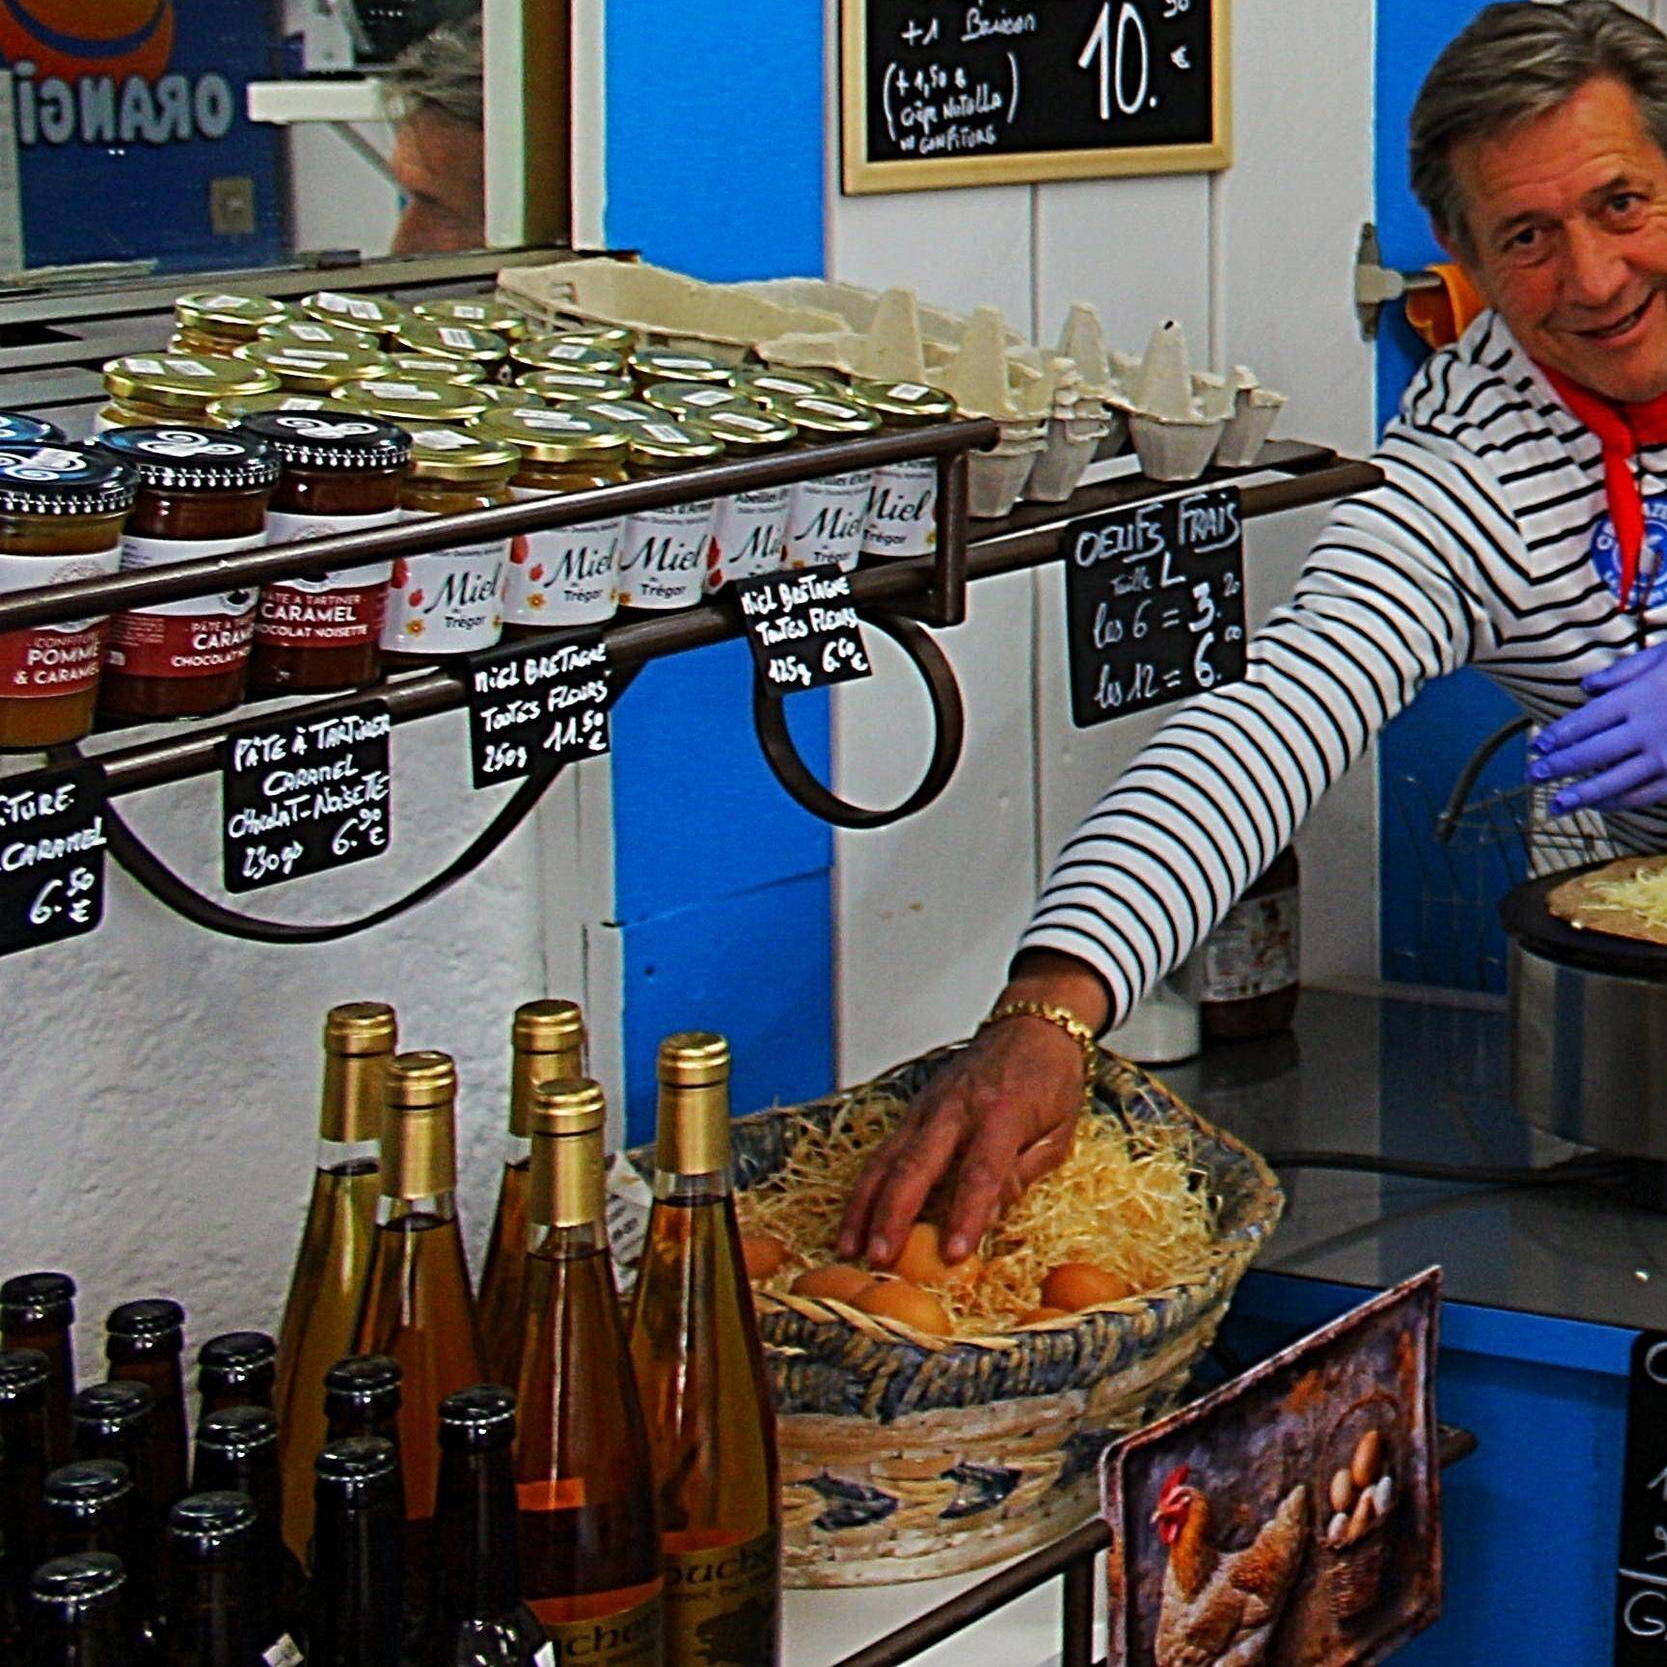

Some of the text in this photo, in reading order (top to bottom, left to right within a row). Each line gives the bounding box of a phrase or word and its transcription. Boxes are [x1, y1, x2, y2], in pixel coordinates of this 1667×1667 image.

[543, 537, 619, 588] Miel
[619, 534, 708, 572] Miel
[424, 562, 502, 614] Miel
[254, 623, 312, 639] HOCOLAT
[261, 602, 358, 623] CARAMEL
[1132, 598, 1153, 638] 6
[27, 641, 100, 666] POMME
[33, 660, 101, 685] CARAME
[262, 752, 359, 797] CARAMEL
